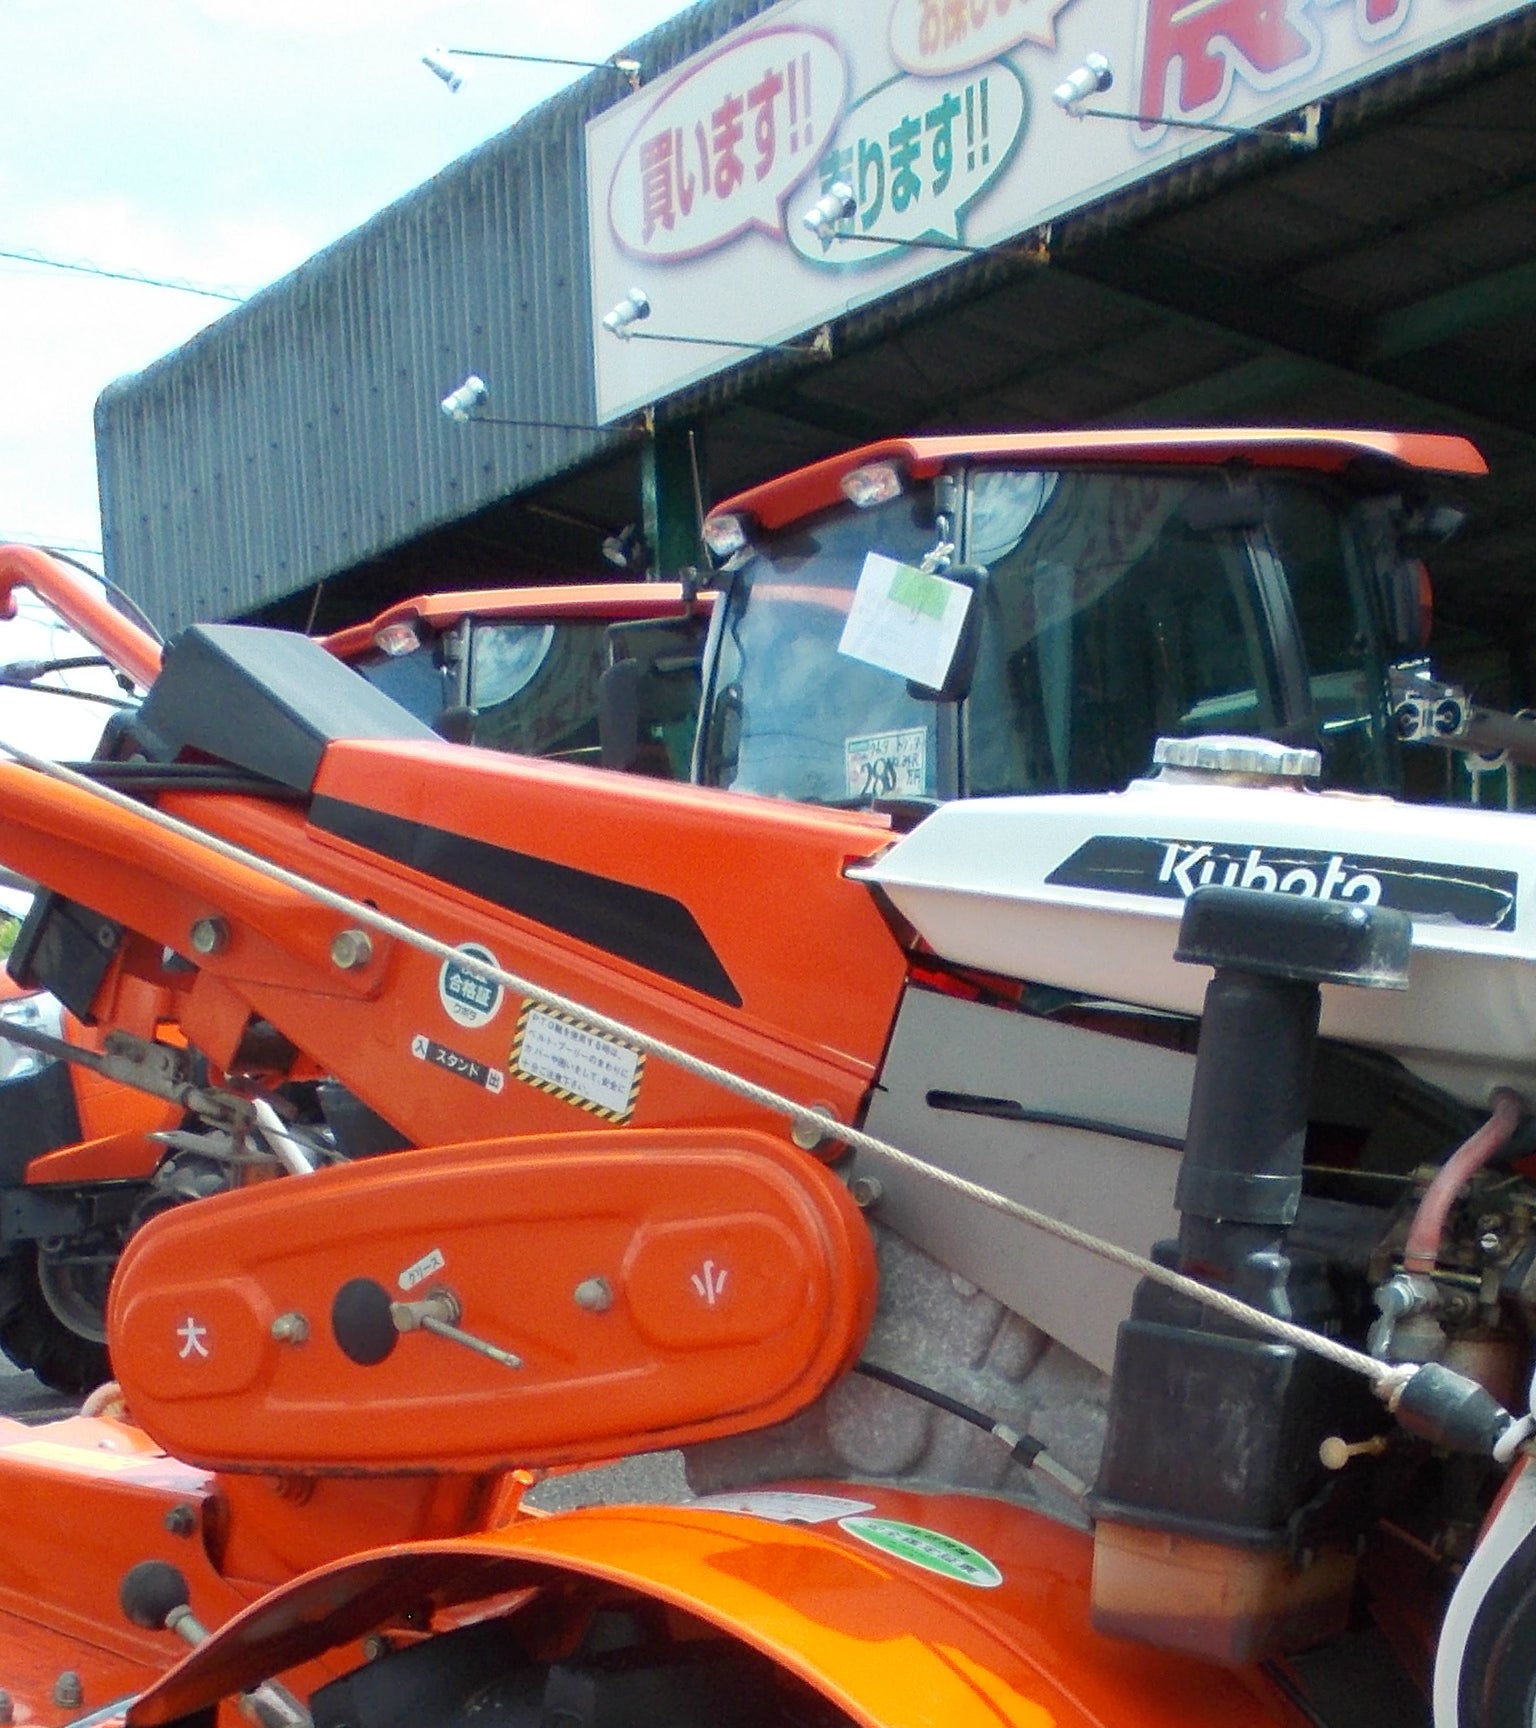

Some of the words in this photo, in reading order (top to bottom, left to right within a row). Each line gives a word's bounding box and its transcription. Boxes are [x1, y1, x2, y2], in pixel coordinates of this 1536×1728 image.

[640, 51, 813, 244] 買います!!
[436, 1048, 479, 1078] スタンド
[177, 1317, 209, 1358] 大
